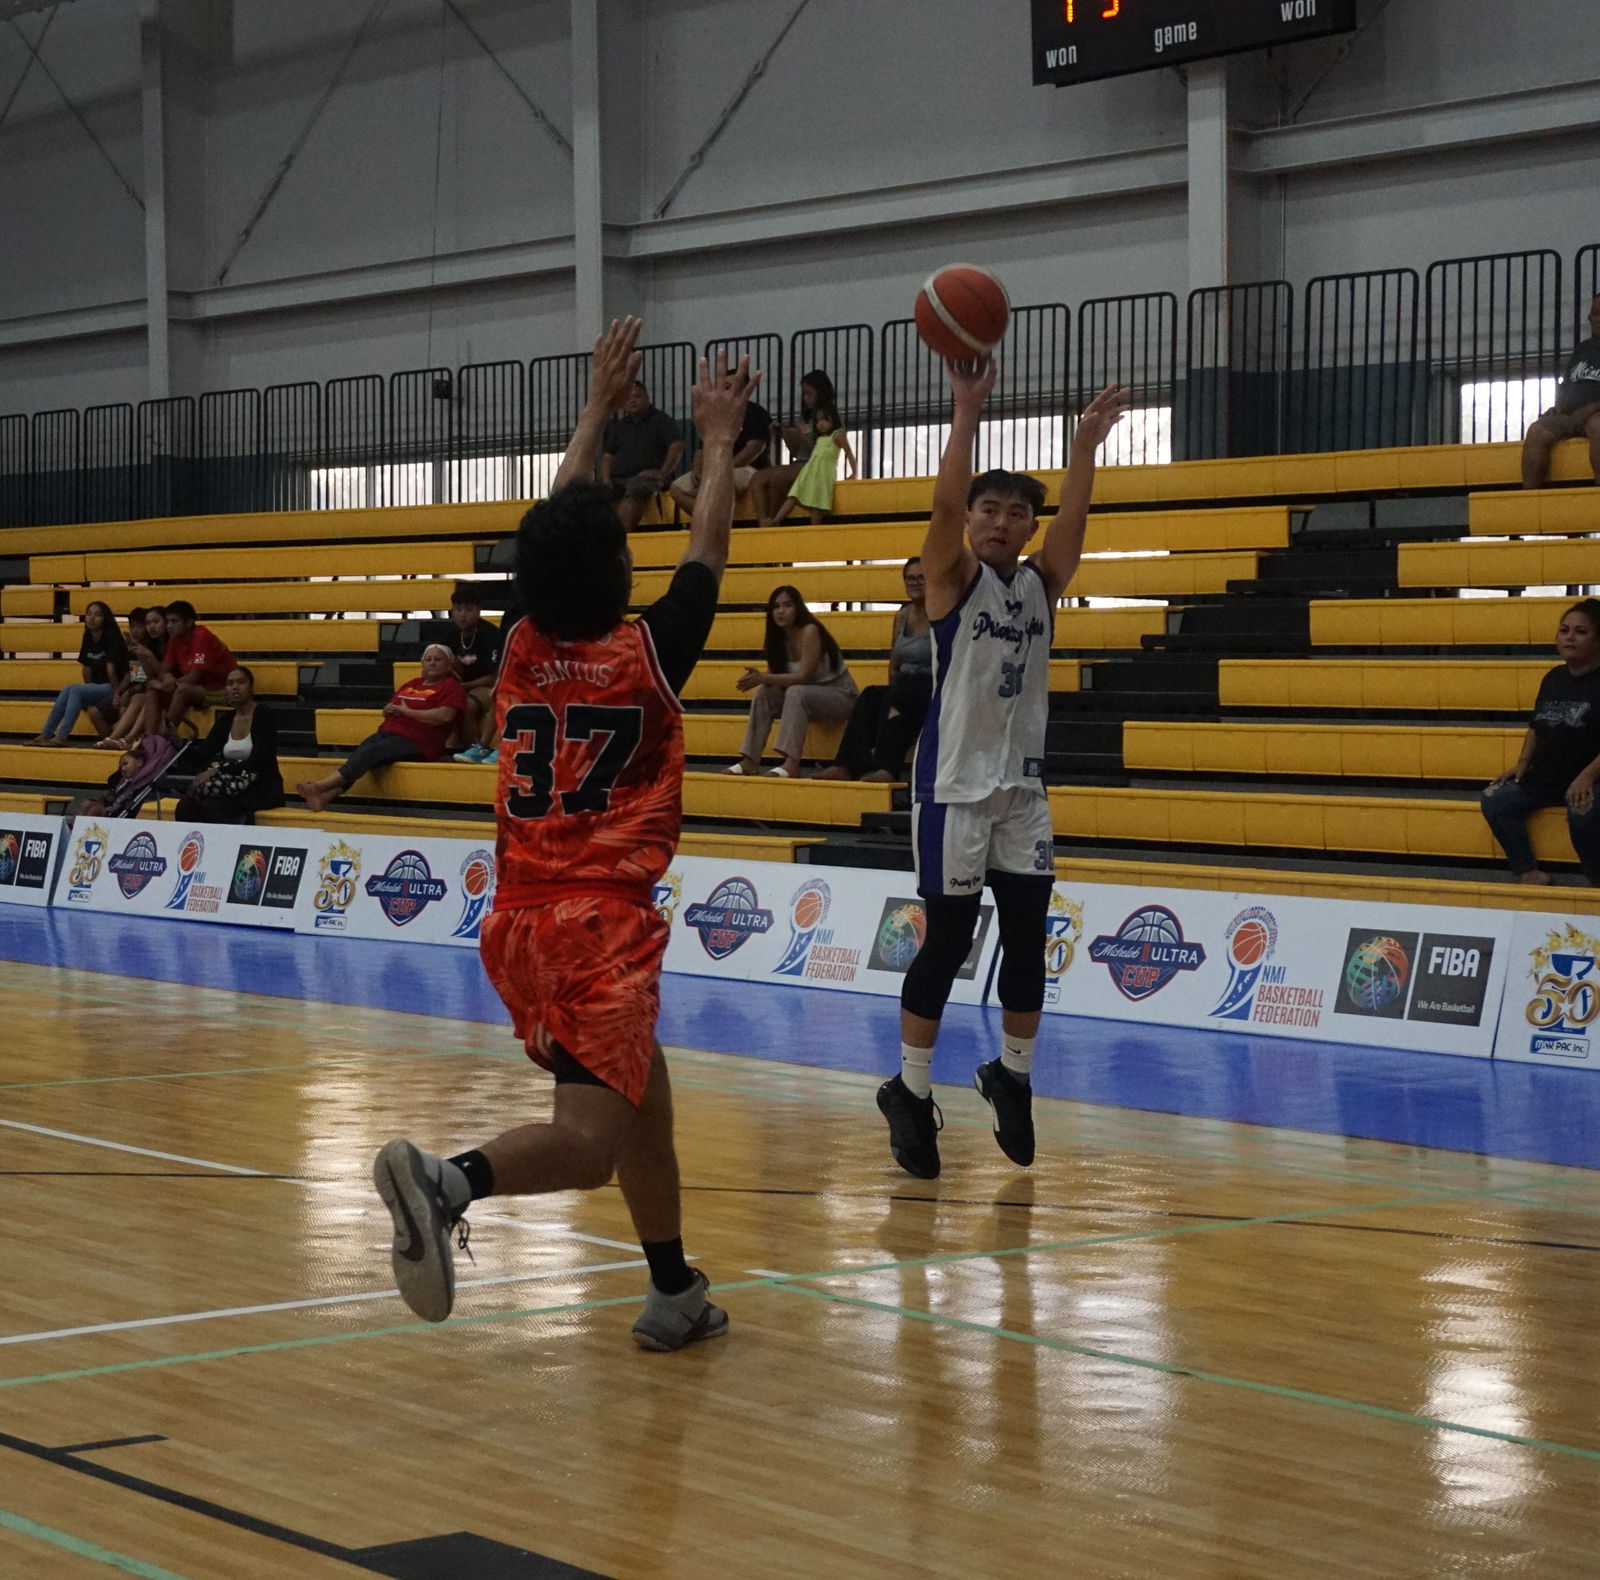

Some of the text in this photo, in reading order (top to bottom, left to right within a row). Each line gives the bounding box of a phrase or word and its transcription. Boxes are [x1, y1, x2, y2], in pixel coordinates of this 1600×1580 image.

[1281, 0, 1316, 22] won
[1154, 21, 1198, 53] game
[1046, 44, 1077, 69] won
[502, 703, 644, 821] 37
[25, 839, 48, 859] FIBA
[139, 861, 164, 872] ULTRA
[274, 855, 300, 876] FIBA
[190, 884, 223, 900] BASKETBALL
[313, 873, 356, 910] 50
[408, 882, 443, 896] ULTRA
[187, 898, 220, 913] FEDERATION
[390, 898, 416, 915] CUP
[687, 908, 724, 924] Michelob
[732, 913, 768, 928] ULTRA
[708, 929, 738, 948] CUP
[814, 928, 835, 945] NMI
[810, 945, 861, 966] BASKETBALL
[1046, 937, 1075, 976] 0
[1093, 942, 1199, 964] Michelob ULTRA
[1428, 946, 1481, 978] FIBA
[805, 962, 857, 983] FEDERATION
[1122, 965, 1160, 989] CUP
[1261, 965, 1286, 985] NMI
[1257, 984, 1324, 1009] BASKETBALL
[1417, 1000, 1475, 1013] We Are Basketball
[1525, 973, 1600, 1028] 50
[1253, 1004, 1321, 1027] FEDERATION
[1555, 1042, 1571, 1052] PAC
